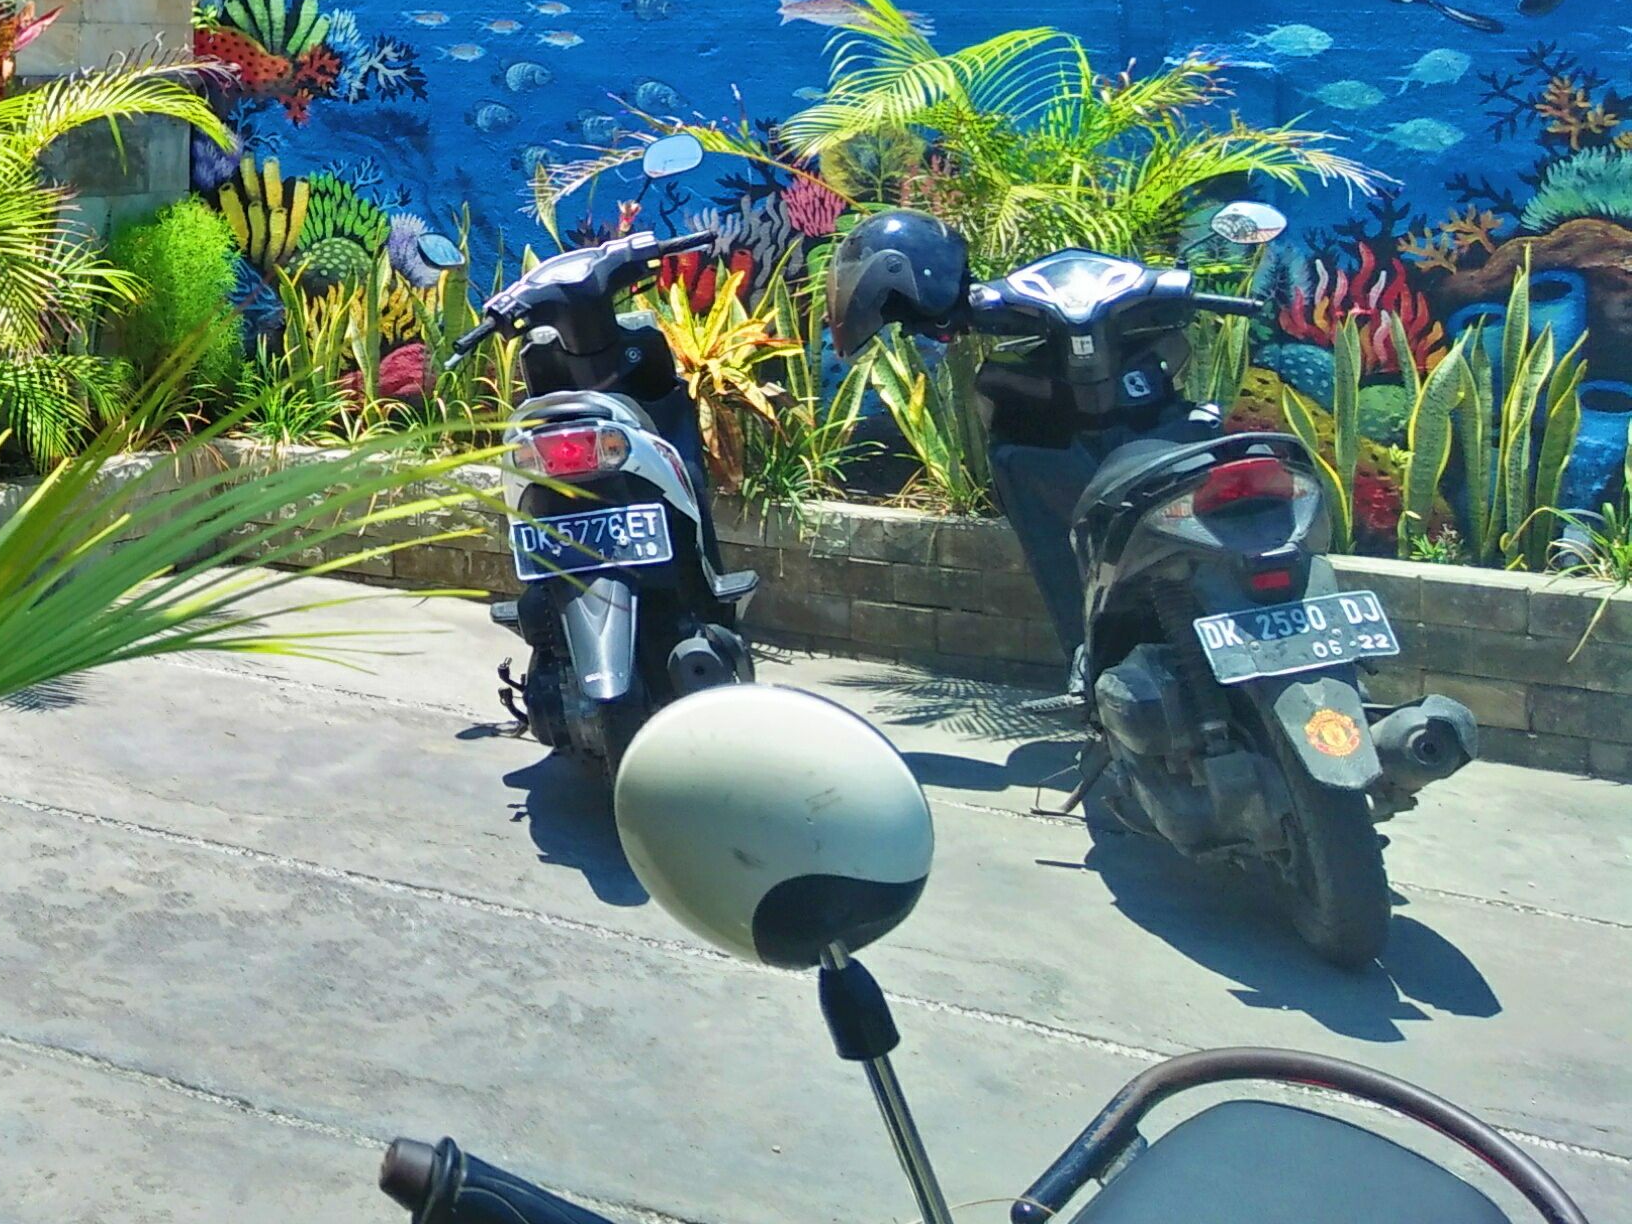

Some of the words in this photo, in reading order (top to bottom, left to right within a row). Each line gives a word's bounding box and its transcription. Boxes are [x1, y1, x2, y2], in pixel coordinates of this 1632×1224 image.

[520, 525, 555, 552] DK
[626, 512, 657, 538] ET
[1200, 618, 1243, 649] DK
[1255, 605, 1327, 641] 2590
[1339, 597, 1380, 624] DJ
